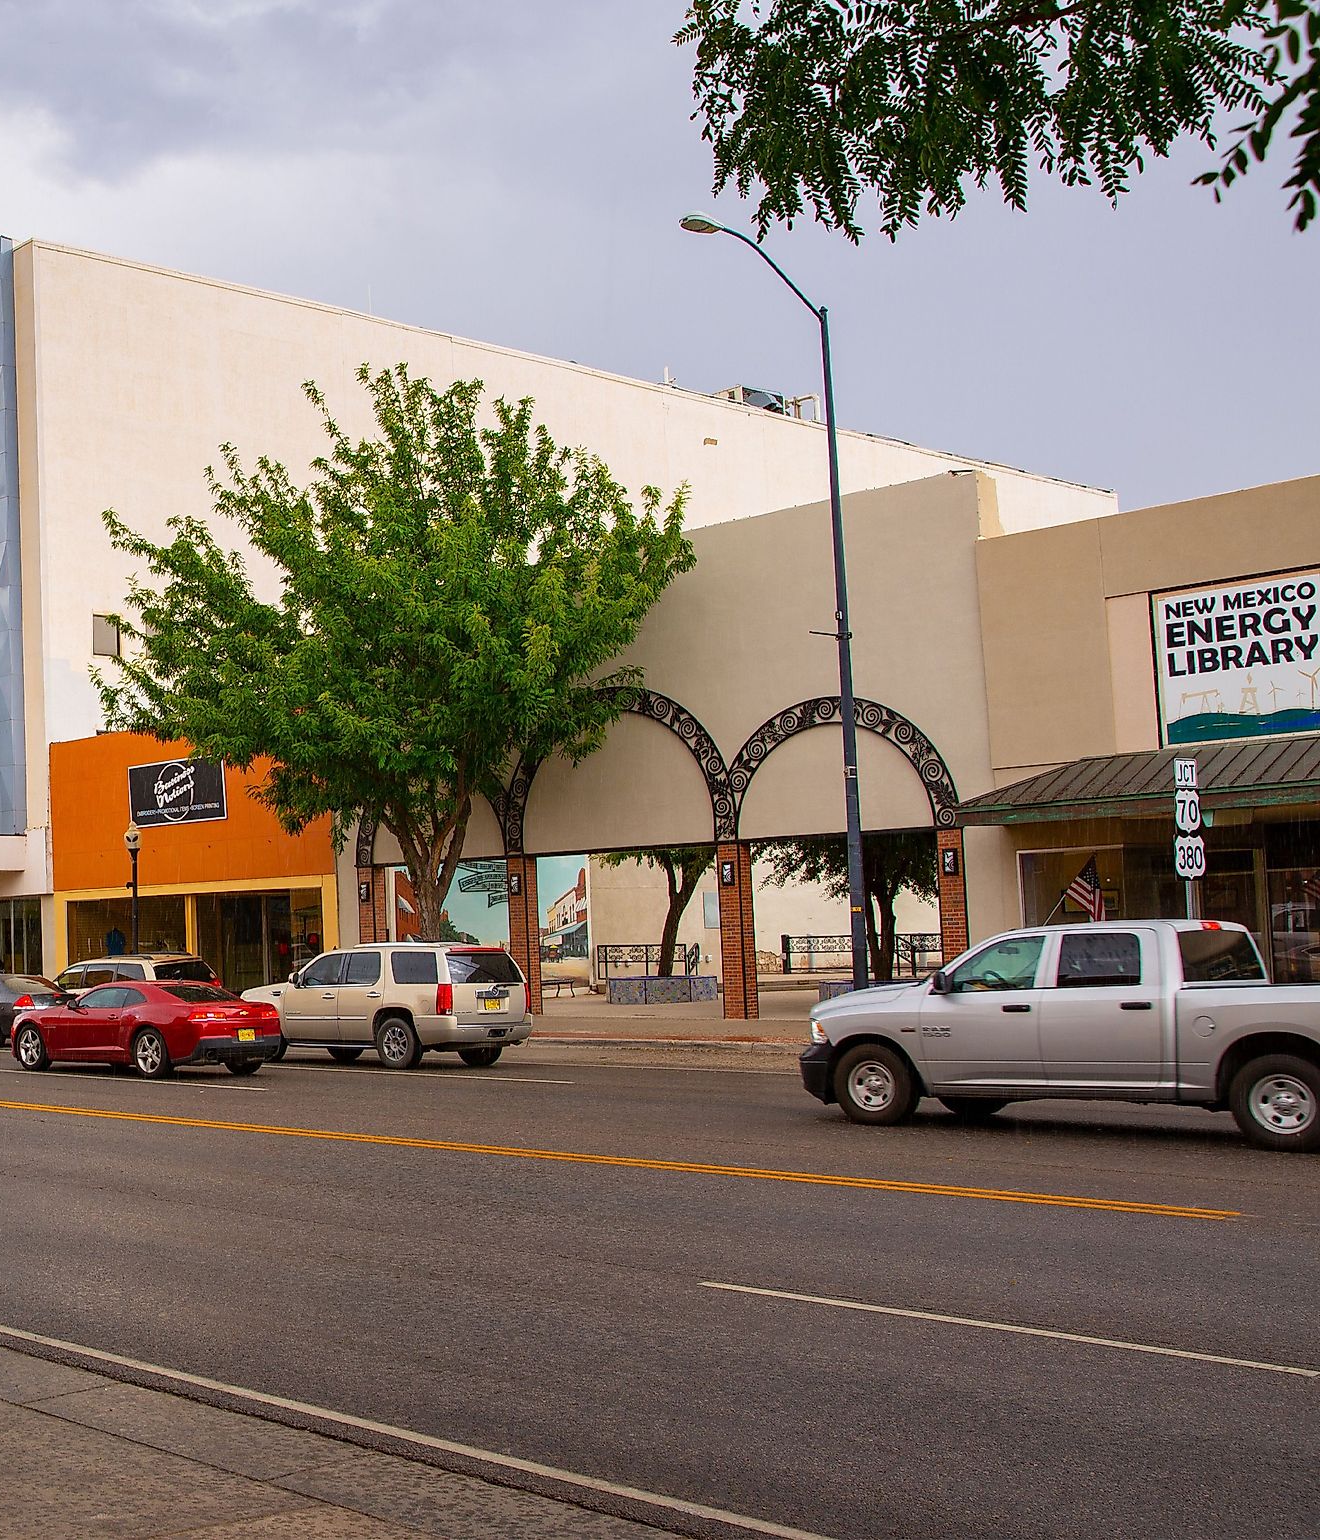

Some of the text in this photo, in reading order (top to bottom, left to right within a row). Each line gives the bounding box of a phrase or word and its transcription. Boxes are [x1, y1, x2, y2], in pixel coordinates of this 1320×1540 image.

[1165, 582, 1316, 620] NEW MEXICO
[1166, 604, 1317, 648] ENERGY
[1167, 634, 1319, 677] LIBRARY
[154, 766, 195, 794] Business
[1178, 764, 1194, 782] JCT
[156, 781, 195, 808] Notions
[1177, 799, 1197, 823] 70
[1178, 846, 1202, 870] 380
